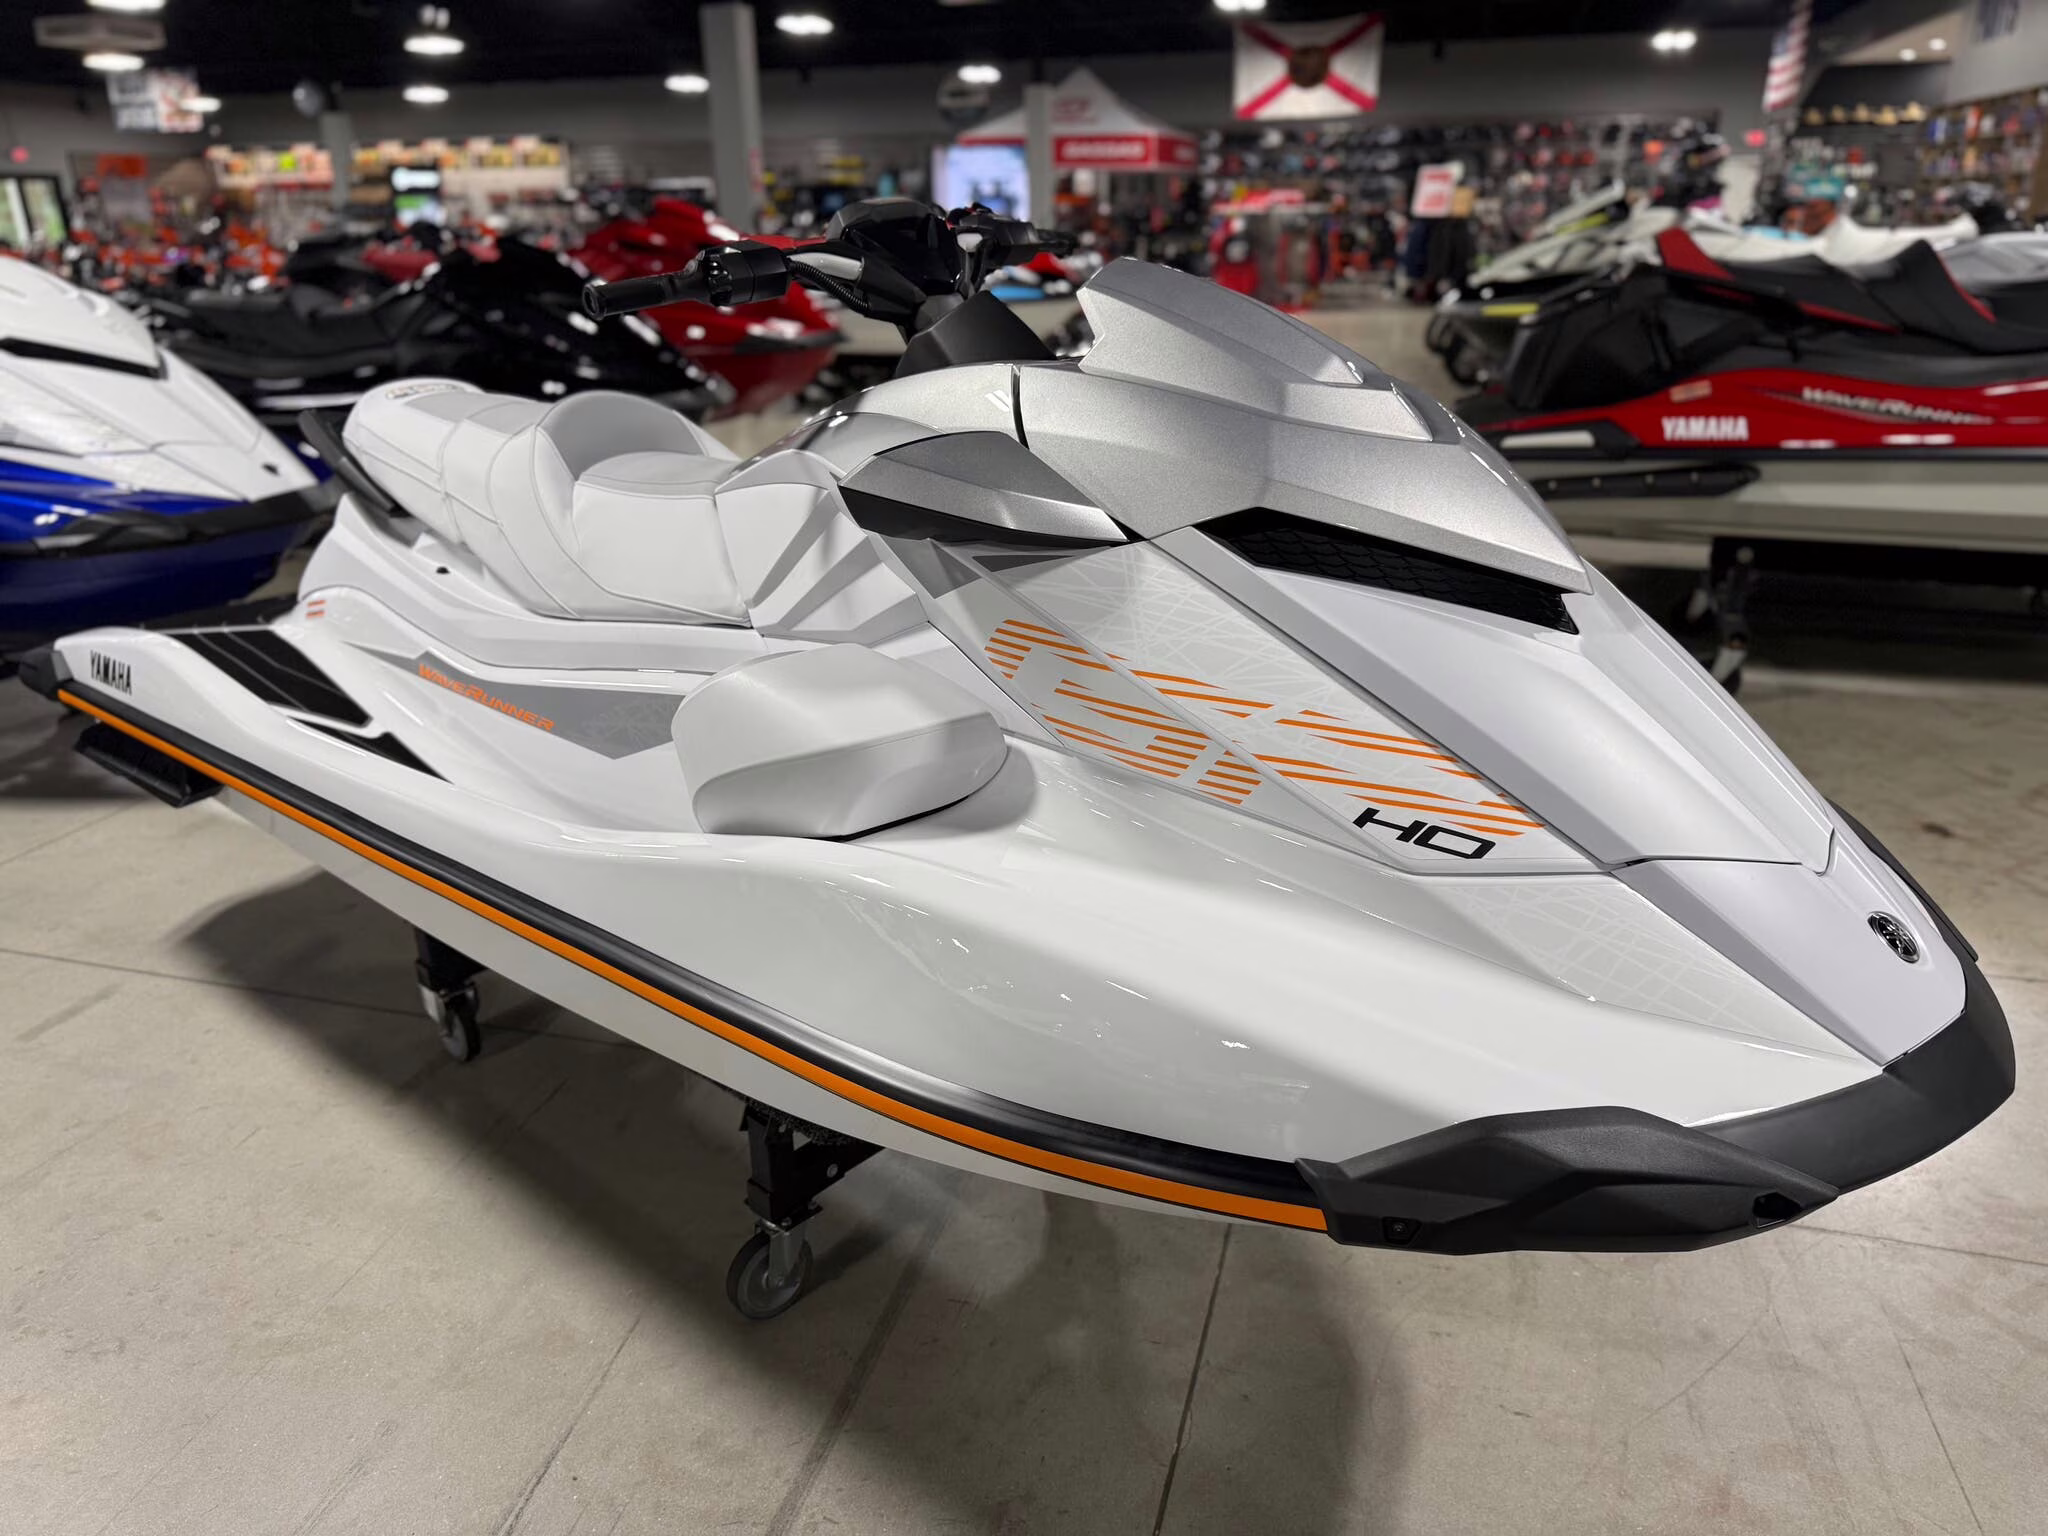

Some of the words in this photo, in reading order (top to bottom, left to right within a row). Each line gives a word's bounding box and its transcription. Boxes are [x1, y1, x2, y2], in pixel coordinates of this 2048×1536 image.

[1662, 417, 1749, 441] YAMAHA
[90, 649, 132, 697] YAMAHA
[1353, 808, 1496, 859] HO
